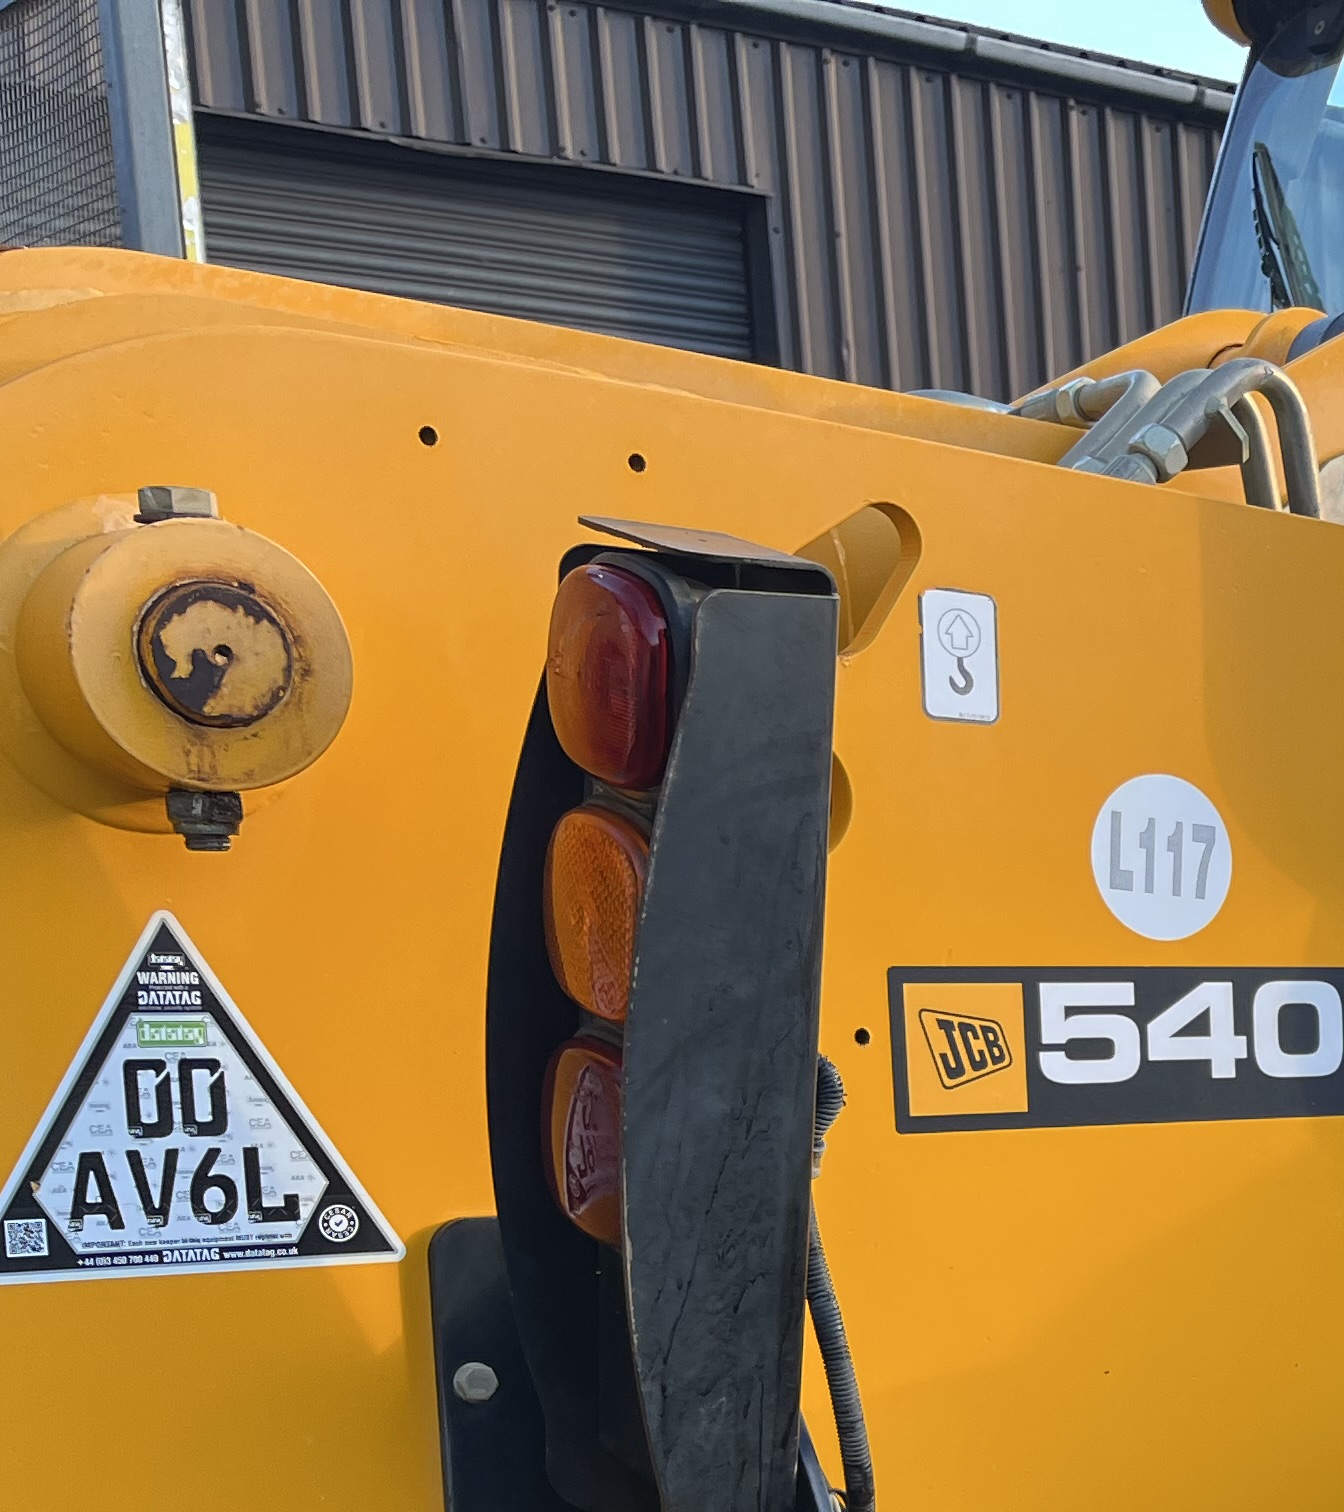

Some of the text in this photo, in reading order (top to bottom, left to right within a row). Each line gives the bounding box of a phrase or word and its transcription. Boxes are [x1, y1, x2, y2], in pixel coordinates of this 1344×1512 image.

[1109, 810, 1217, 900] L117
[136, 971, 199, 985] WARNING
[137, 990, 202, 1005] DATATAG
[938, 1019, 1009, 1081] JCB
[69, 1146, 301, 1231] AV6L
[162, 1247, 221, 1263] DATATAG
[222, 1245, 299, 1259] www.datatag.co.uk
